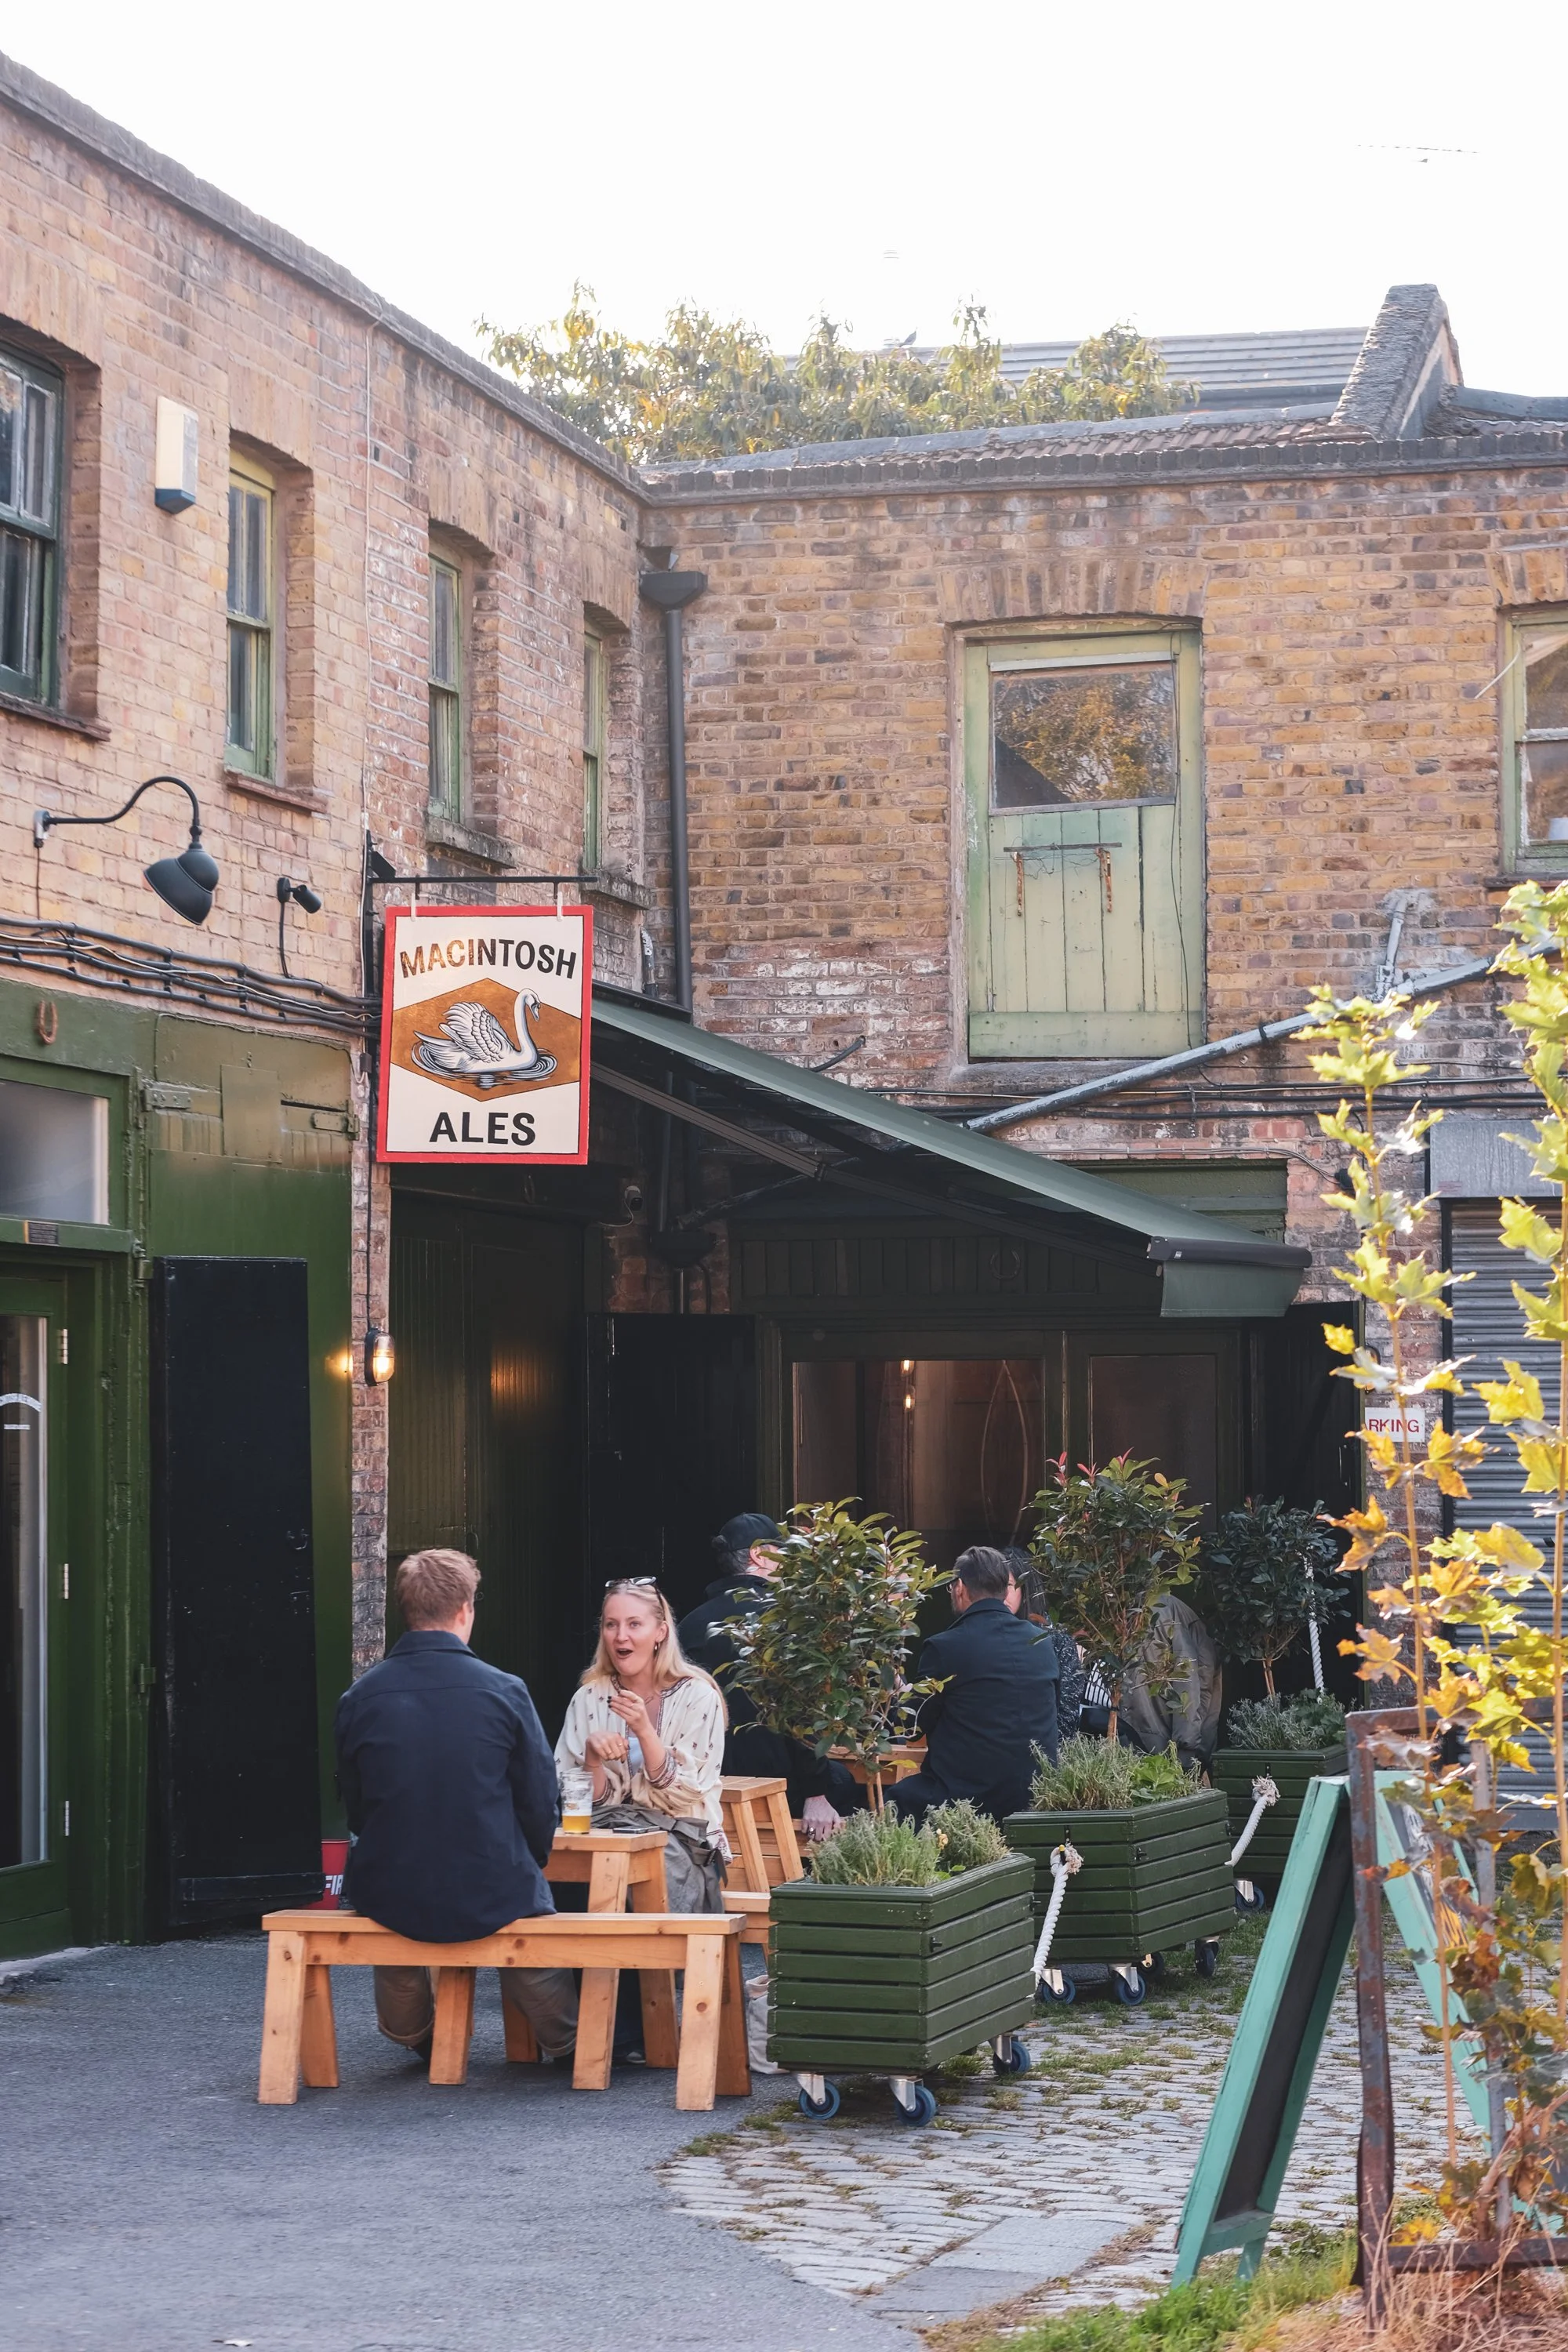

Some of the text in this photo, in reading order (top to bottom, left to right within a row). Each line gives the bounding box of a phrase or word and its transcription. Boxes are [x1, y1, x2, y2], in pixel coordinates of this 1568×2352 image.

[400, 938, 576, 979] MACINTOSH
[429, 1111, 535, 1146] ALES
[1364, 1418, 1419, 1433] RKING
[325, 1875, 343, 1895] FIR
